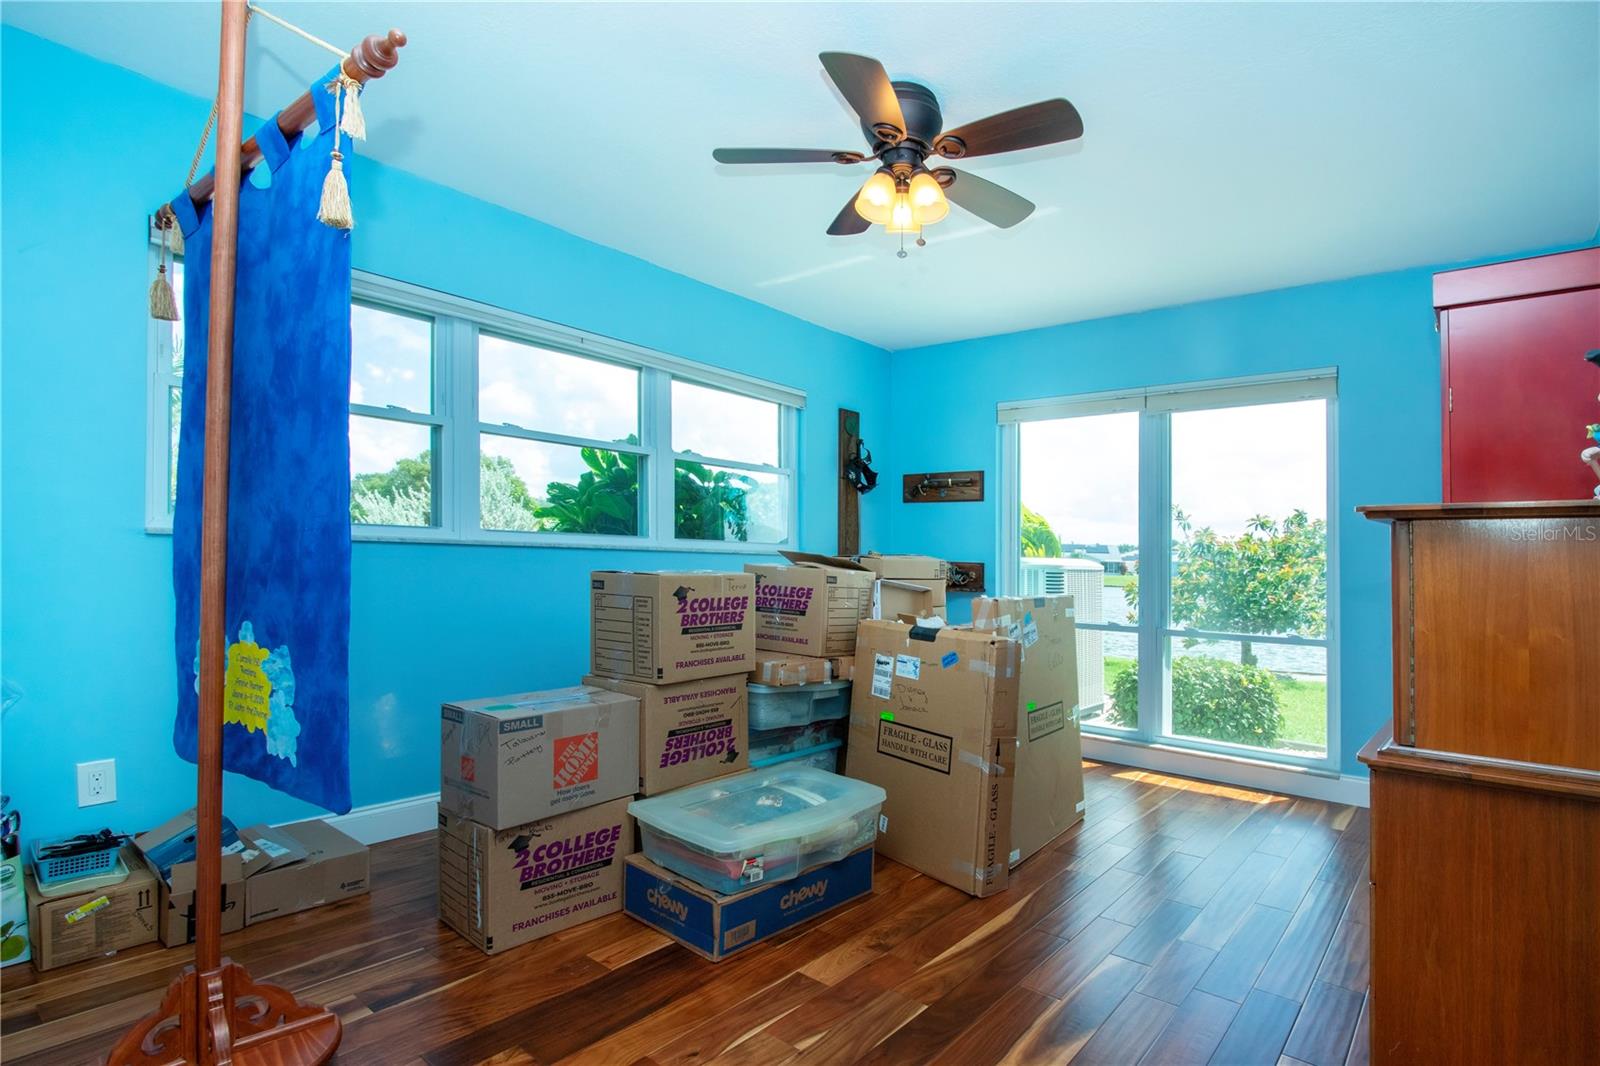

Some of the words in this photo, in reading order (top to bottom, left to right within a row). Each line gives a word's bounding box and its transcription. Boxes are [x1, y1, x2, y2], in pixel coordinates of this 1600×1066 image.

[677, 598, 689, 614] 2
[689, 597, 749, 612] COLLEGE
[755, 597, 809, 610] BROTHERS
[762, 585, 814, 600] COLLEGE
[680, 611, 745, 627] BROTHERS
[781, 635, 809, 645] AVAILABLE
[675, 657, 715, 669] FRANCHISES
[715, 653, 746, 664] AVAILABLE
[663, 692, 699, 705] AVAILABLE
[700, 686, 737, 699] FRANCHISES
[503, 718, 539, 731] SMALL
[559, 740, 578, 762] THE
[665, 725, 733, 752] BROTHERS
[726, 737, 737, 753] 2
[881, 738, 909, 754] HANDLE
[909, 746, 928, 759] WITH
[928, 751, 948, 765] CARE
[883, 725, 917, 745] FRAGILE
[922, 736, 948, 753] GLASS
[555, 732, 598, 786] HOME
[571, 749, 598, 784] DEPOT
[659, 740, 727, 769] COLLEGE
[990, 783, 999, 821] GLASS
[512, 848, 531, 869] 2
[532, 824, 622, 863] COLLEGE
[985, 830, 997, 886] FRAGILE
[520, 843, 616, 883] BROTHERS
[534, 882, 564, 896] MOVING
[569, 870, 600, 886] STORAGE
[542, 882, 594, 901] 855-MOVE-BRO
[780, 879, 828, 910] chewy
[512, 906, 570, 933] FRANCHISES
[572, 890, 618, 915] AVAILABLE
[647, 888, 688, 921] chewy
